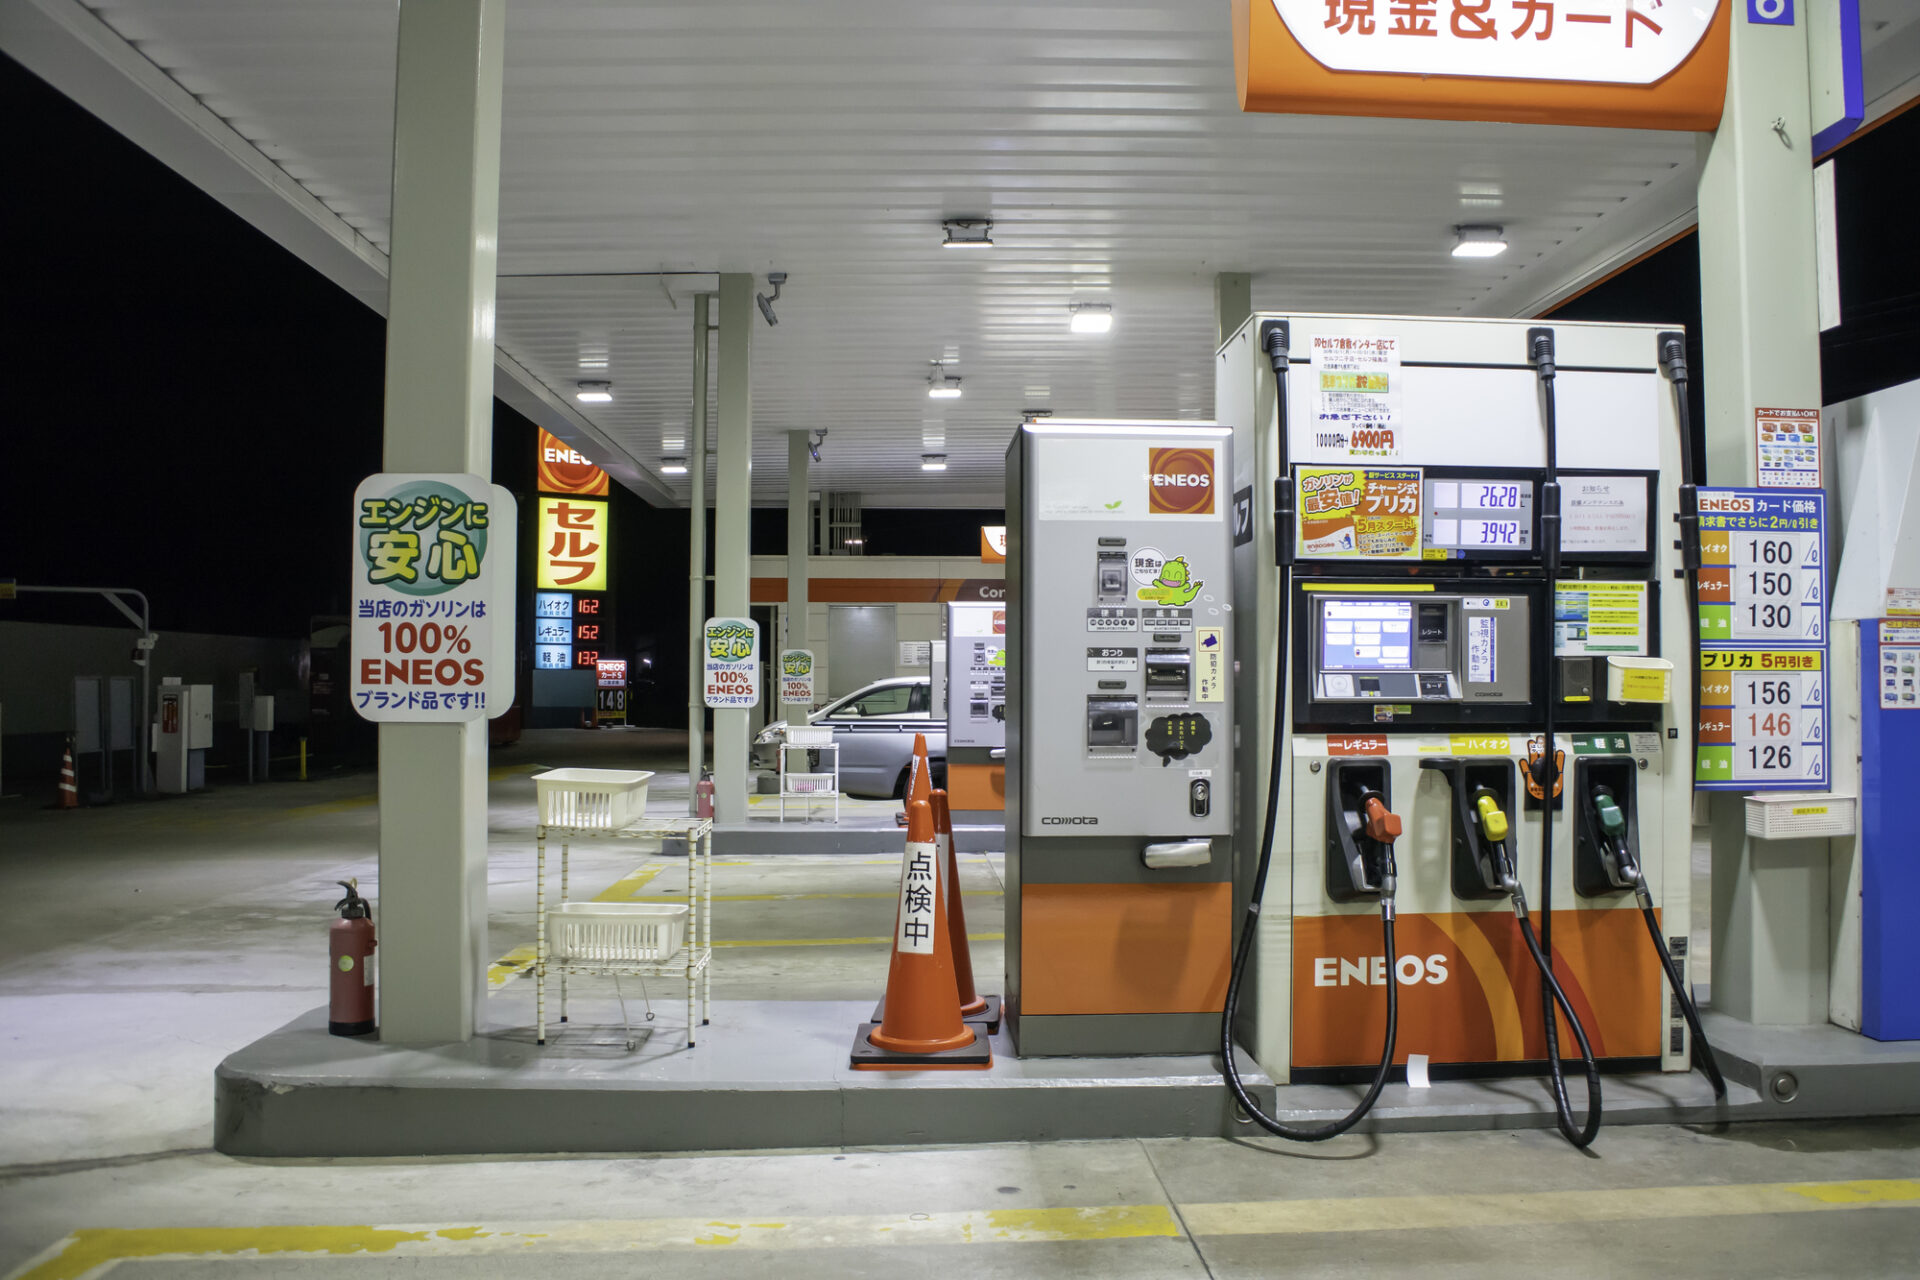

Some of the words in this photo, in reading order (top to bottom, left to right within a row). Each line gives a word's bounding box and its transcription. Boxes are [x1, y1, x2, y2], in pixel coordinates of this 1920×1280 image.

[1351, 430, 1394, 448] 6900円
[1153, 474, 1210, 488] ENEOS
[1302, 472, 1354, 492] ガソリンが
[1368, 483, 1417, 494] チャージ式
[1306, 488, 1361, 514] 最安値!
[1366, 495, 1416, 514] プリカ
[1700, 498, 1751, 511] ENEOS
[1756, 500, 1816, 514] カード価格
[360, 495, 489, 530] エンジンに
[547, 502, 600, 586] セルフ
[1749, 539, 1792, 564] 160
[368, 530, 480, 584] 安心
[1135, 558, 1162, 568] 現金は
[979, 586, 1006, 598] Cor
[1749, 571, 1792, 596] 150
[358, 600, 486, 618] 当店のガソリンは
[539, 600, 569, 610] ハイオク
[578, 600, 599, 614] 162
[1749, 604, 1791, 628] 130
[378, 622, 471, 654] 100%
[538, 626, 570, 636] レギュラー
[578, 626, 599, 640] 152
[707, 626, 754, 638] エンジンに
[1480, 619, 1488, 664] 監視カメラ
[543, 652, 566, 662] 軽油
[578, 651, 598, 665] 132
[710, 638, 751, 658] 安心
[1472, 645, 1480, 672] 作動中
[1703, 654, 1753, 668] プリカ
[1761, 654, 1814, 668] 5円引き
[361, 658, 485, 686] ENEOS
[714, 672, 748, 683] 100%
[708, 685, 753, 694] ENEOS
[1748, 680, 1790, 704] 156
[357, 691, 486, 710] ブランド品です!!
[600, 690, 624, 710] 148
[1749, 713, 1791, 736] 146
[1344, 740, 1386, 750] レギュラー
[1468, 740, 1508, 749] ハイオク
[1749, 746, 1791, 770] 126
[904, 851, 932, 947] 点検中
[1314, 954, 1448, 986] ENEOS
